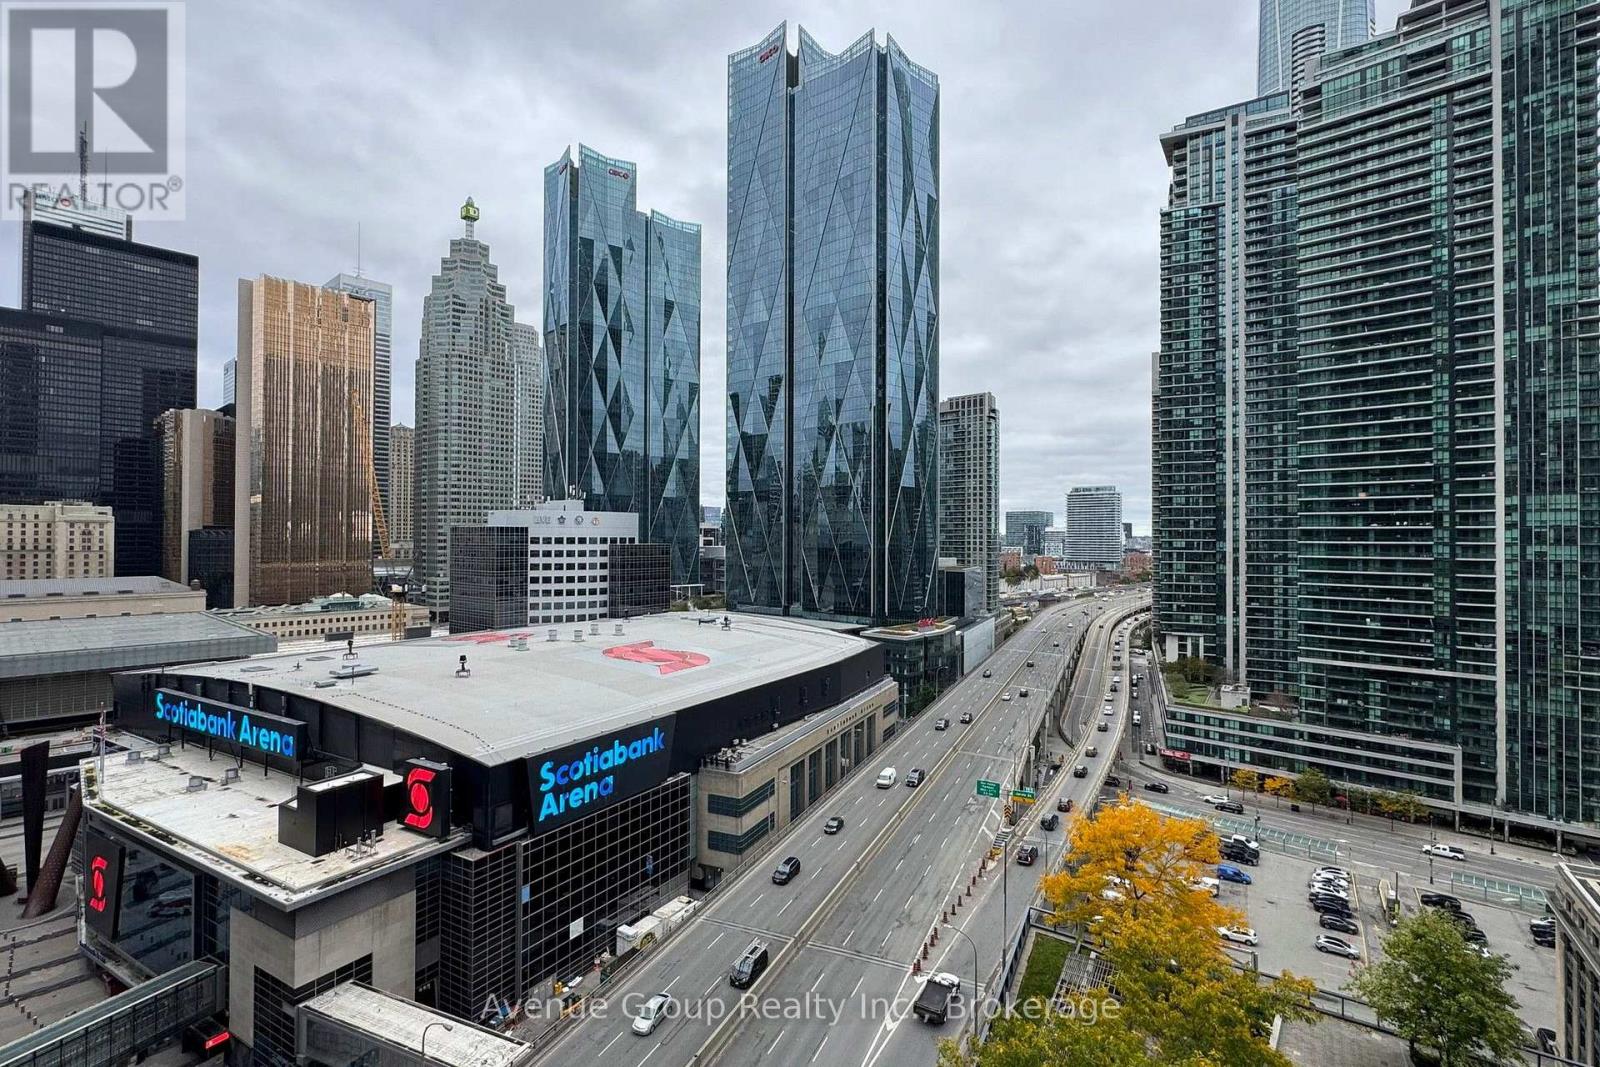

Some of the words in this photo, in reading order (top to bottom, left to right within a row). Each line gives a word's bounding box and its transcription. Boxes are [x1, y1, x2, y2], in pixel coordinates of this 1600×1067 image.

[155, 692, 237, 740] Scotiabank
[239, 715, 294, 757] Arena
[539, 727, 665, 791] Scotiabank
[538, 775, 614, 822] Arena
